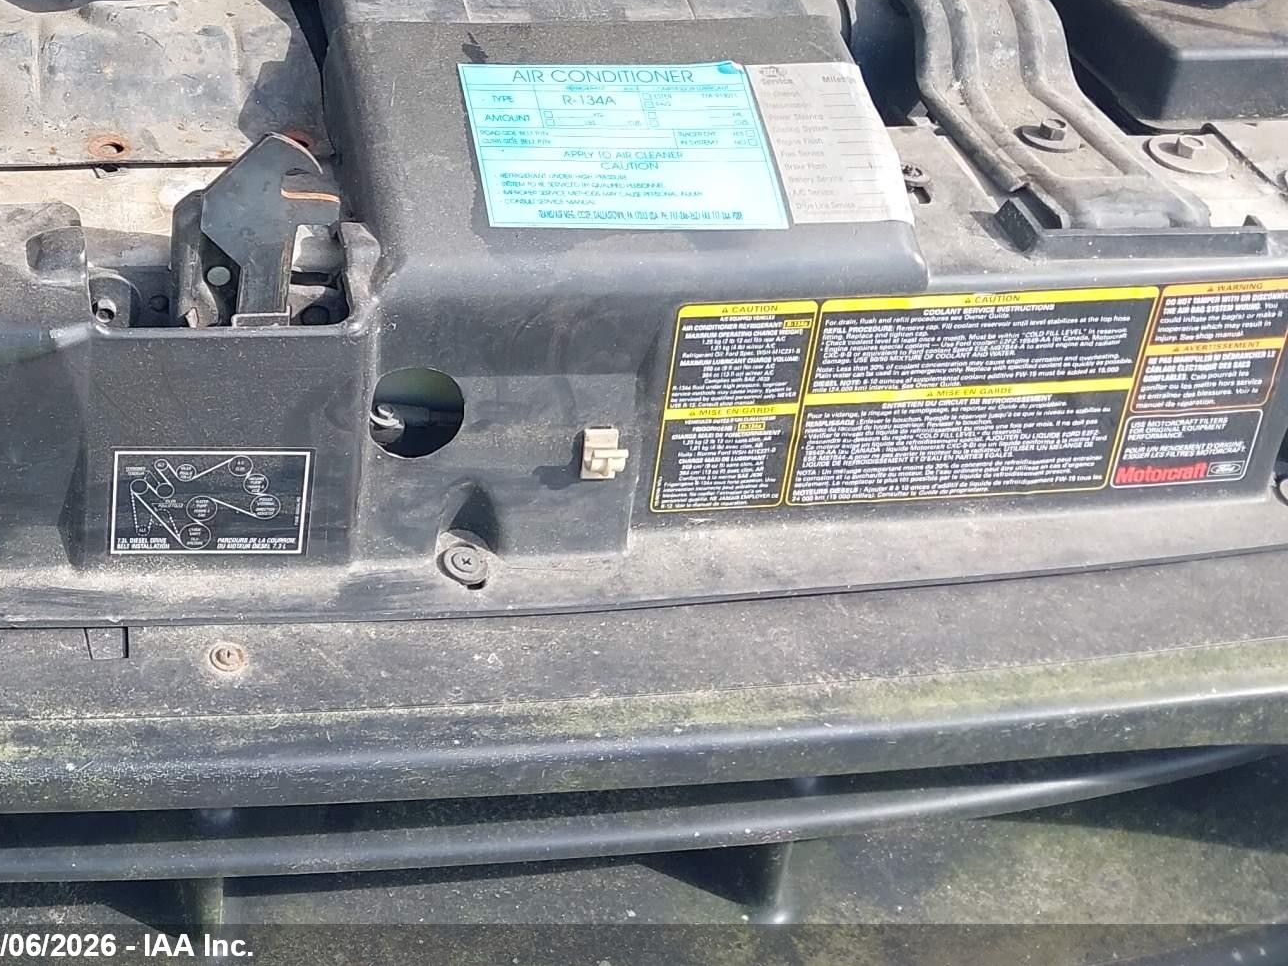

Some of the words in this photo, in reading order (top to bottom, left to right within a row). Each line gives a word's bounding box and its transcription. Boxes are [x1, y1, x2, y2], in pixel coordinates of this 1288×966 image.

[512, 70, 544, 82] AIR
[551, 70, 694, 83] CONDITIONER
[492, 95, 514, 103] TYPE
[562, 94, 616, 106] R-134A
[485, 114, 530, 122] AMOUNT
[564, 150, 594, 158] APPLY
[635, 151, 684, 159] CLEANER
[600, 162, 659, 170] CAUTION
[1217, 283, 1263, 292] WARNING
[975, 295, 1021, 304] CAUTION
[1166, 298, 1176, 306] DO
[1177, 297, 1192, 305] NOT
[1193, 296, 1220, 304] TAMPER
[1222, 294, 1240, 302] WITH
[1240, 294, 1252, 302] OR
[732, 305, 778, 314] CAUTION
[924, 308, 962, 316] COOLANT
[963, 306, 996, 314] SERVICE
[997, 304, 1055, 312] INSTRUCTIONS
[1178, 306, 1190, 314] AIR
[1190, 305, 1206, 313] BAG
[1206, 304, 1234, 312] SYSTEM
[826, 318, 837, 326] For
[838, 318, 858, 326] drain,
[878, 316, 892, 324] and
[910, 314, 950, 324] procedures
[988, 312, 1010, 320] Guide.
[1160, 316, 1182, 324] could
[1183, 314, 1206, 322] inflate
[1256, 310, 1277, 318] make
[1158, 324, 1200, 334] inoperative
[1200, 322, 1223, 330] which
[1224, 322, 1240, 330] may
[1242, 320, 1263, 328] result
[1155, 334, 1178, 342] injury.
[1195, 332, 1214, 340] shop
[1184, 342, 1261, 352] AVERTISSEMENT
[964, 388, 976, 396] EN
[980, 387, 1013, 395] GARDE
[742, 406, 777, 414] GARDE
[1147, 418, 1199, 428] MOTORCRAFT
[1199, 417, 1228, 425] FILTERS
[1146, 426, 1180, 434] ORIGINAL
[1182, 424, 1226, 432] EQUIPMENT
[1127, 432, 1184, 441] PERFORMANCE.
[1124, 446, 1146, 454] POUR
[1160, 443, 1206, 452] RENDEMENT
[1122, 452, 1150, 460] EXIGER
[1165, 450, 1195, 458] FILTRES
[1114, 461, 1208, 484] Motorcraft
